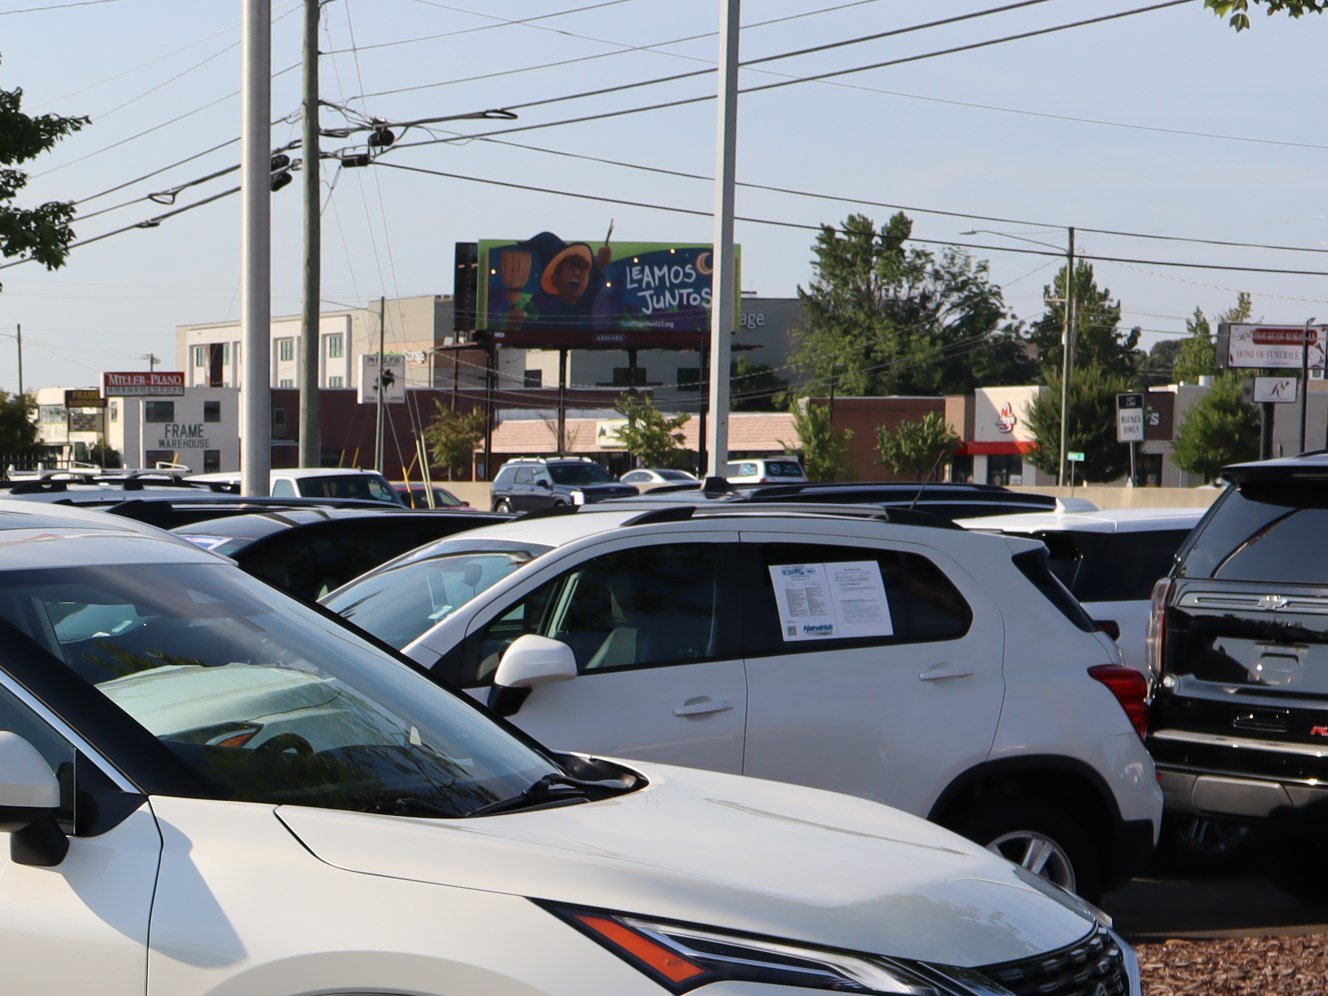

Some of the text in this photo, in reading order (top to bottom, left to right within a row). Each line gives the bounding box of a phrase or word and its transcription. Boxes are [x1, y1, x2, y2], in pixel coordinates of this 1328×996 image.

[625, 264, 697, 290] LEAMOS
[637, 287, 712, 315] JUNTOS
[739, 313, 765, 330] age
[108, 373, 182, 386] MILLER PIANO
[1121, 415, 1141, 424] BUSES
[165, 423, 204, 439] FRAME
[1123, 426, 1140, 434] ONLY
[158, 439, 210, 449] WAREHOUSE
